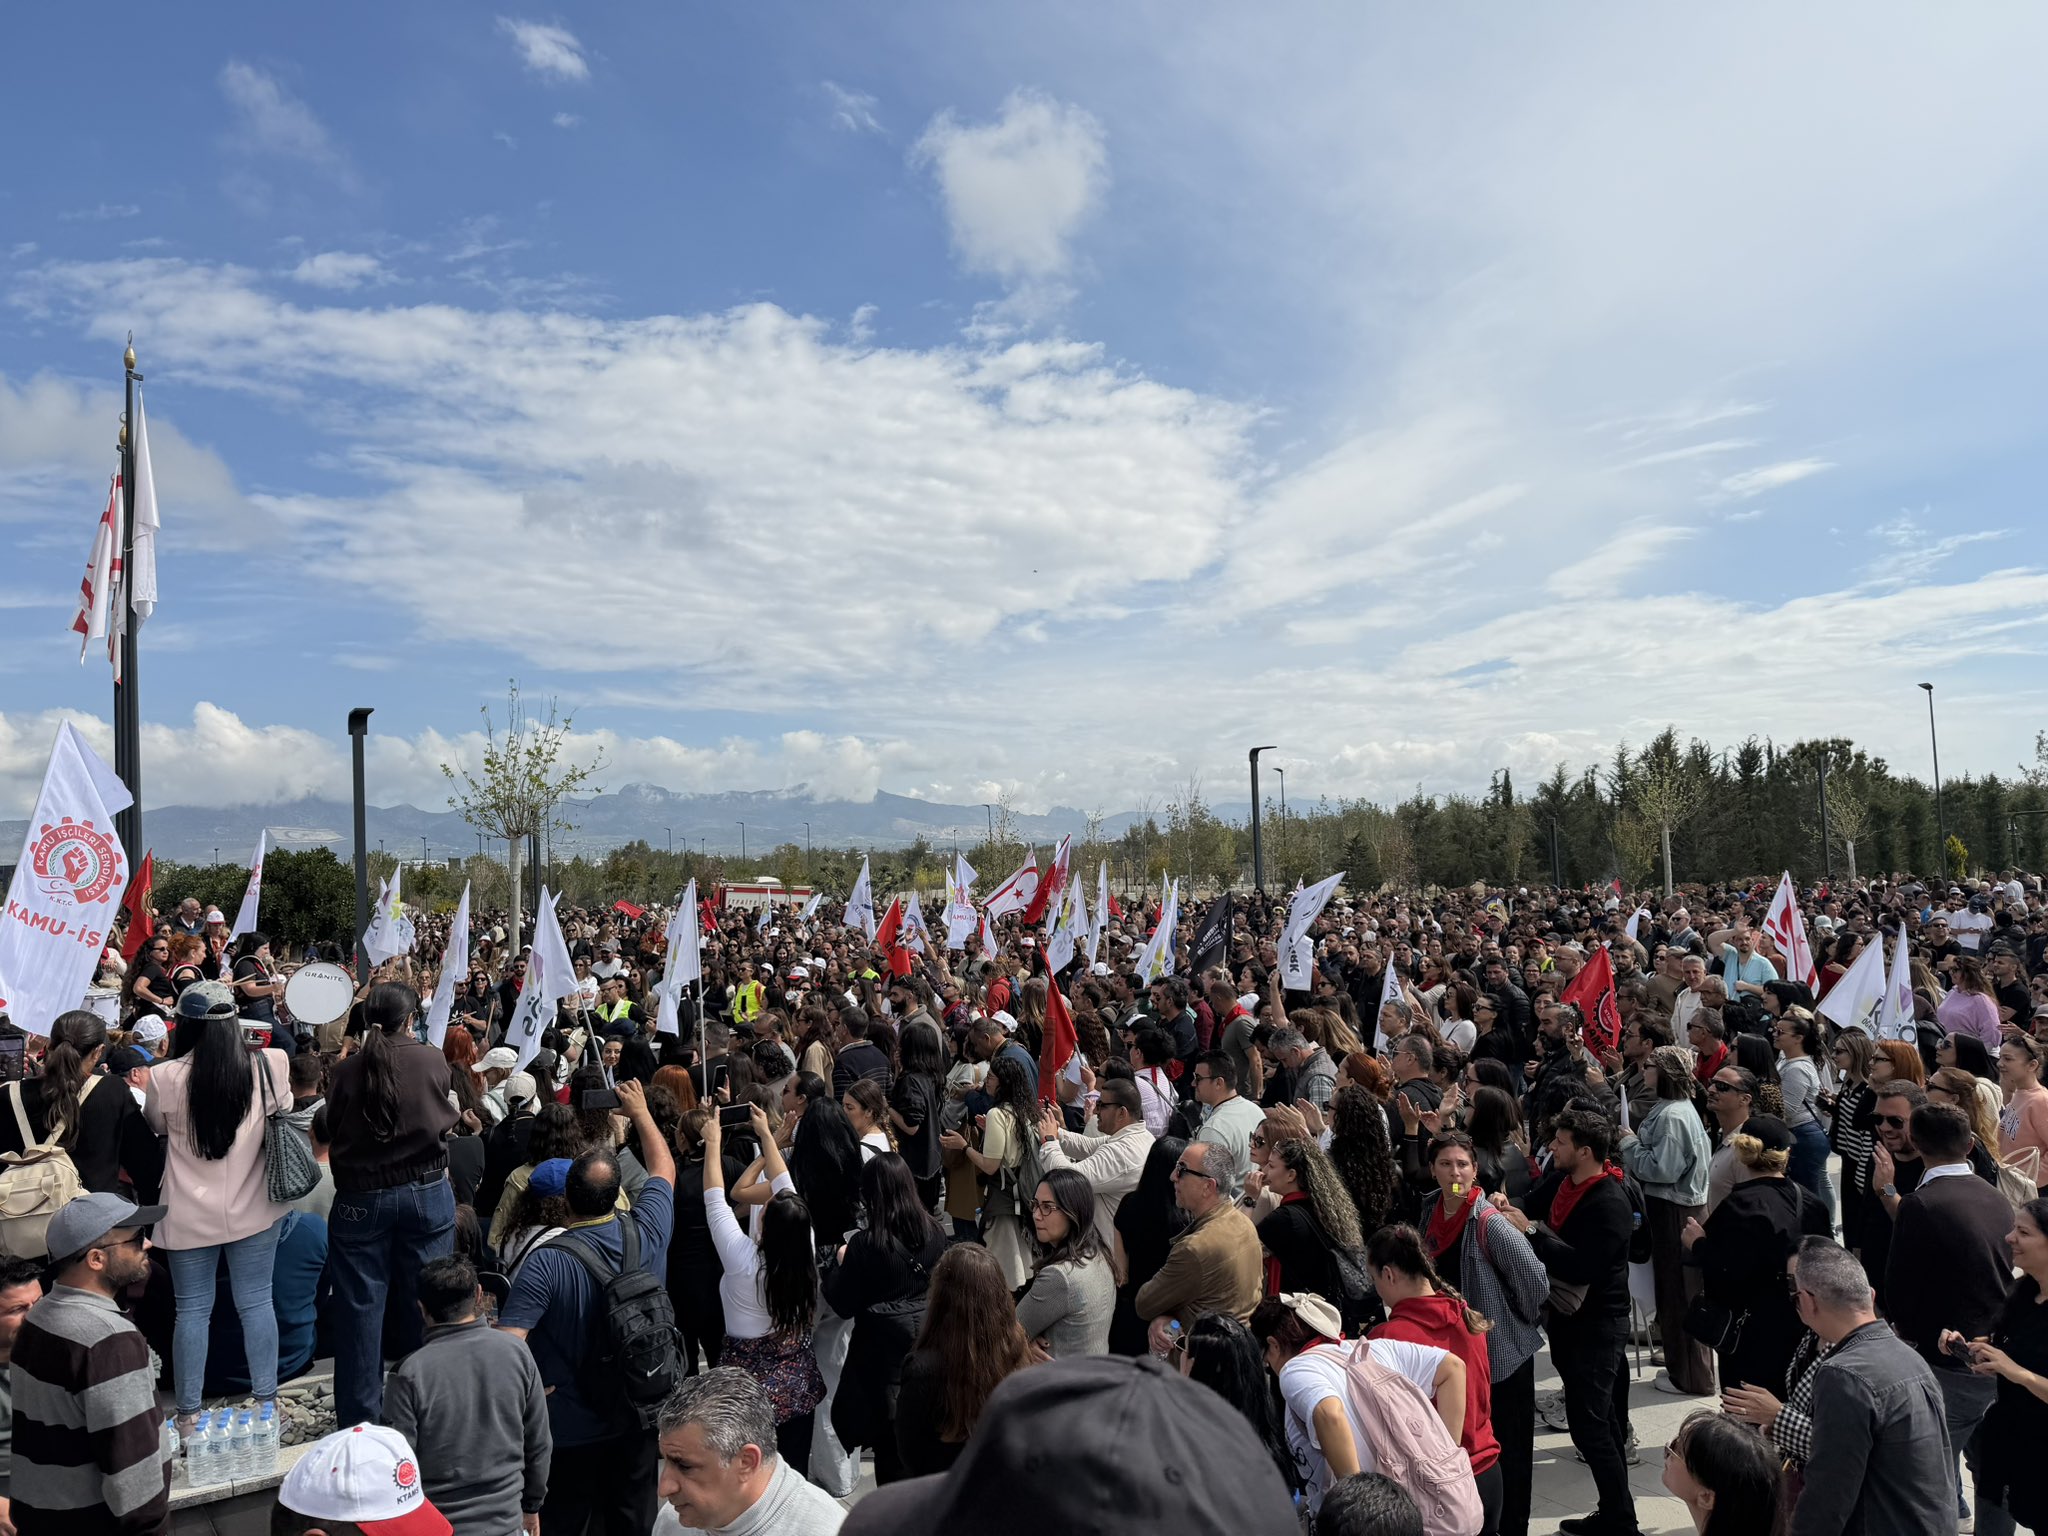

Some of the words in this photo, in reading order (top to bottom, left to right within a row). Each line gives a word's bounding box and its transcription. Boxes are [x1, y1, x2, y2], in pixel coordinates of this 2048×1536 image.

[37, 836, 55, 867] KAMU
[56, 827, 102, 847] İŞÇİLERİ
[7, 899, 101, 949] KAMU-İŞ
[304, 971, 344, 982] GRANITE
[396, 1486, 419, 1504] KTAMS
